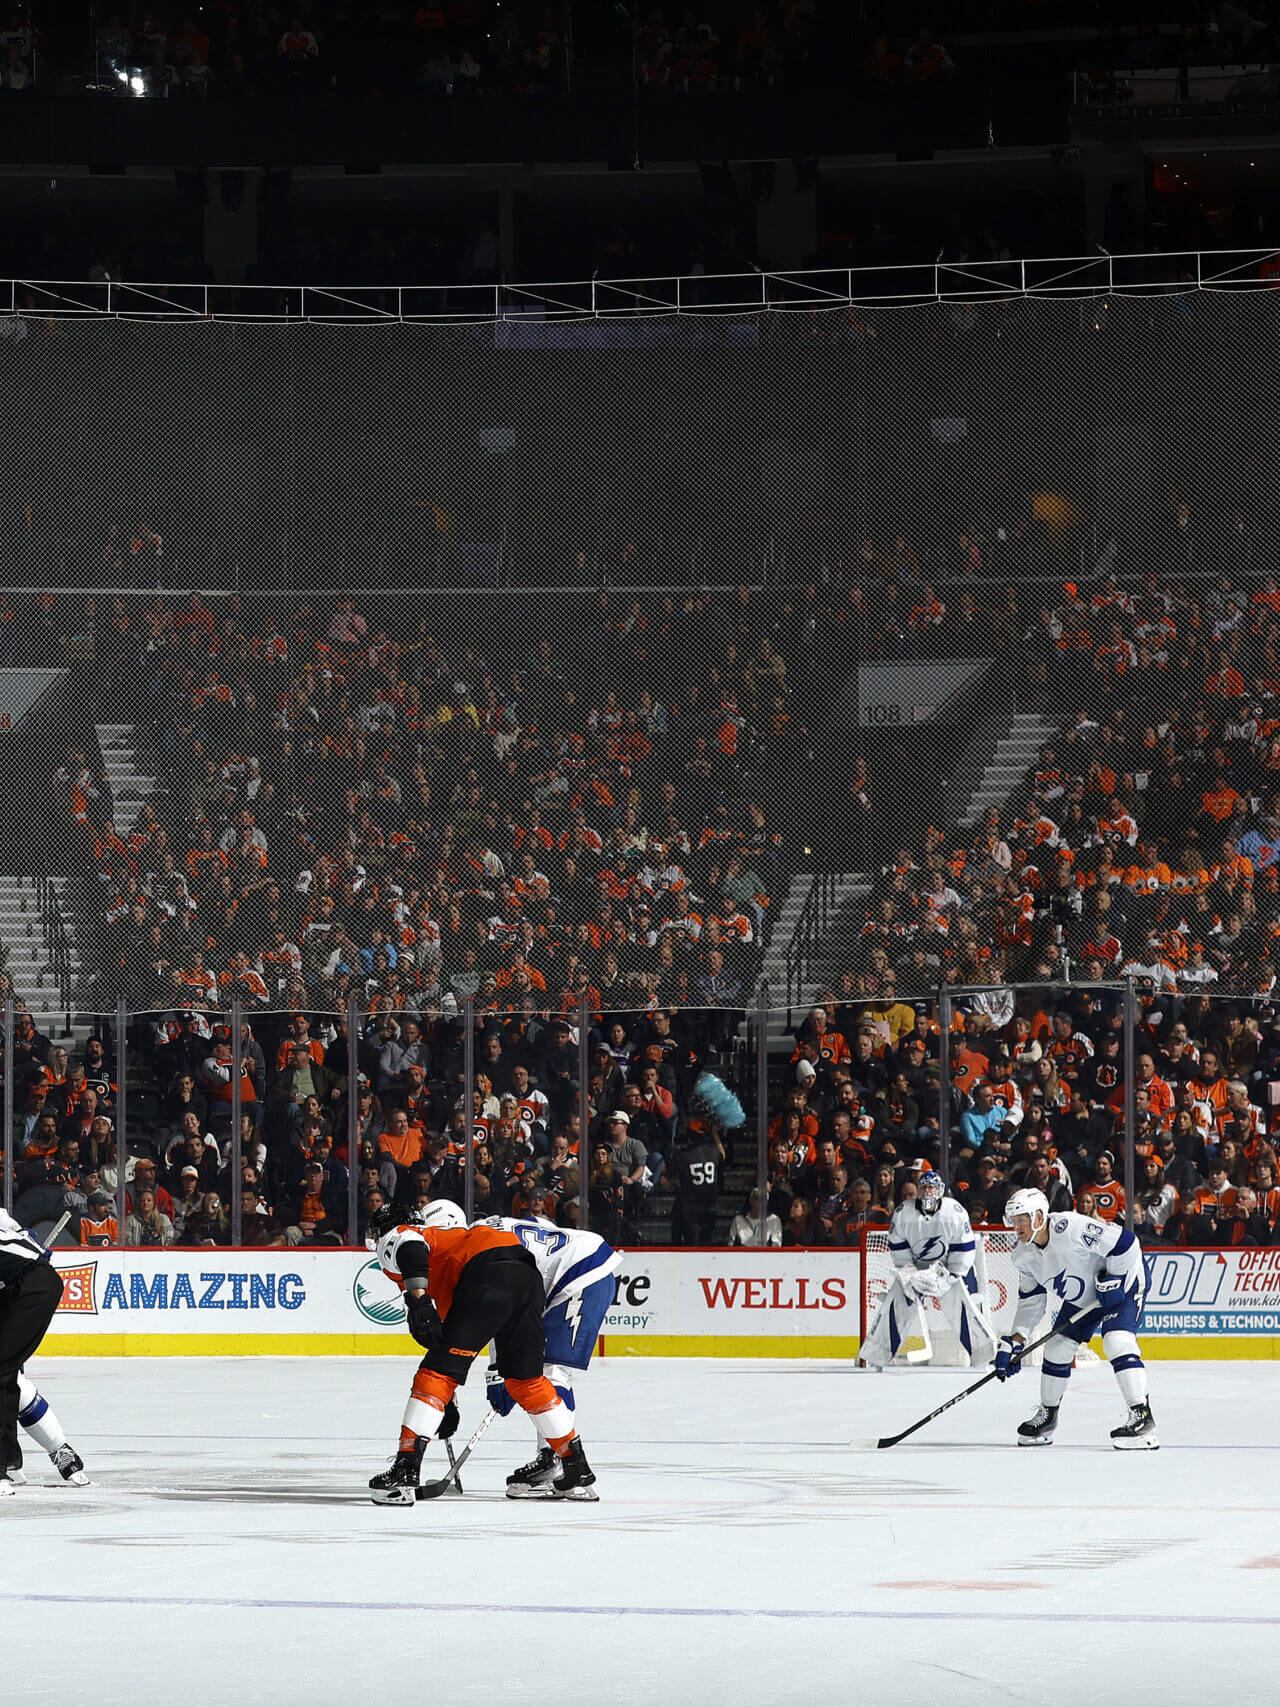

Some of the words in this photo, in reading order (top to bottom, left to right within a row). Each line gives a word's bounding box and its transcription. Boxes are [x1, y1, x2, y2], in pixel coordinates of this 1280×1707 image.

[689, 1161, 714, 1185] 59
[1081, 1222, 1104, 1249] 43
[101, 1272, 306, 1310] AMAZING
[610, 1274, 651, 1307] re
[698, 1278, 847, 1310] WELLS
[1145, 1314, 1206, 1330] BUSINESS
[1208, 1315, 1219, 1328] &
